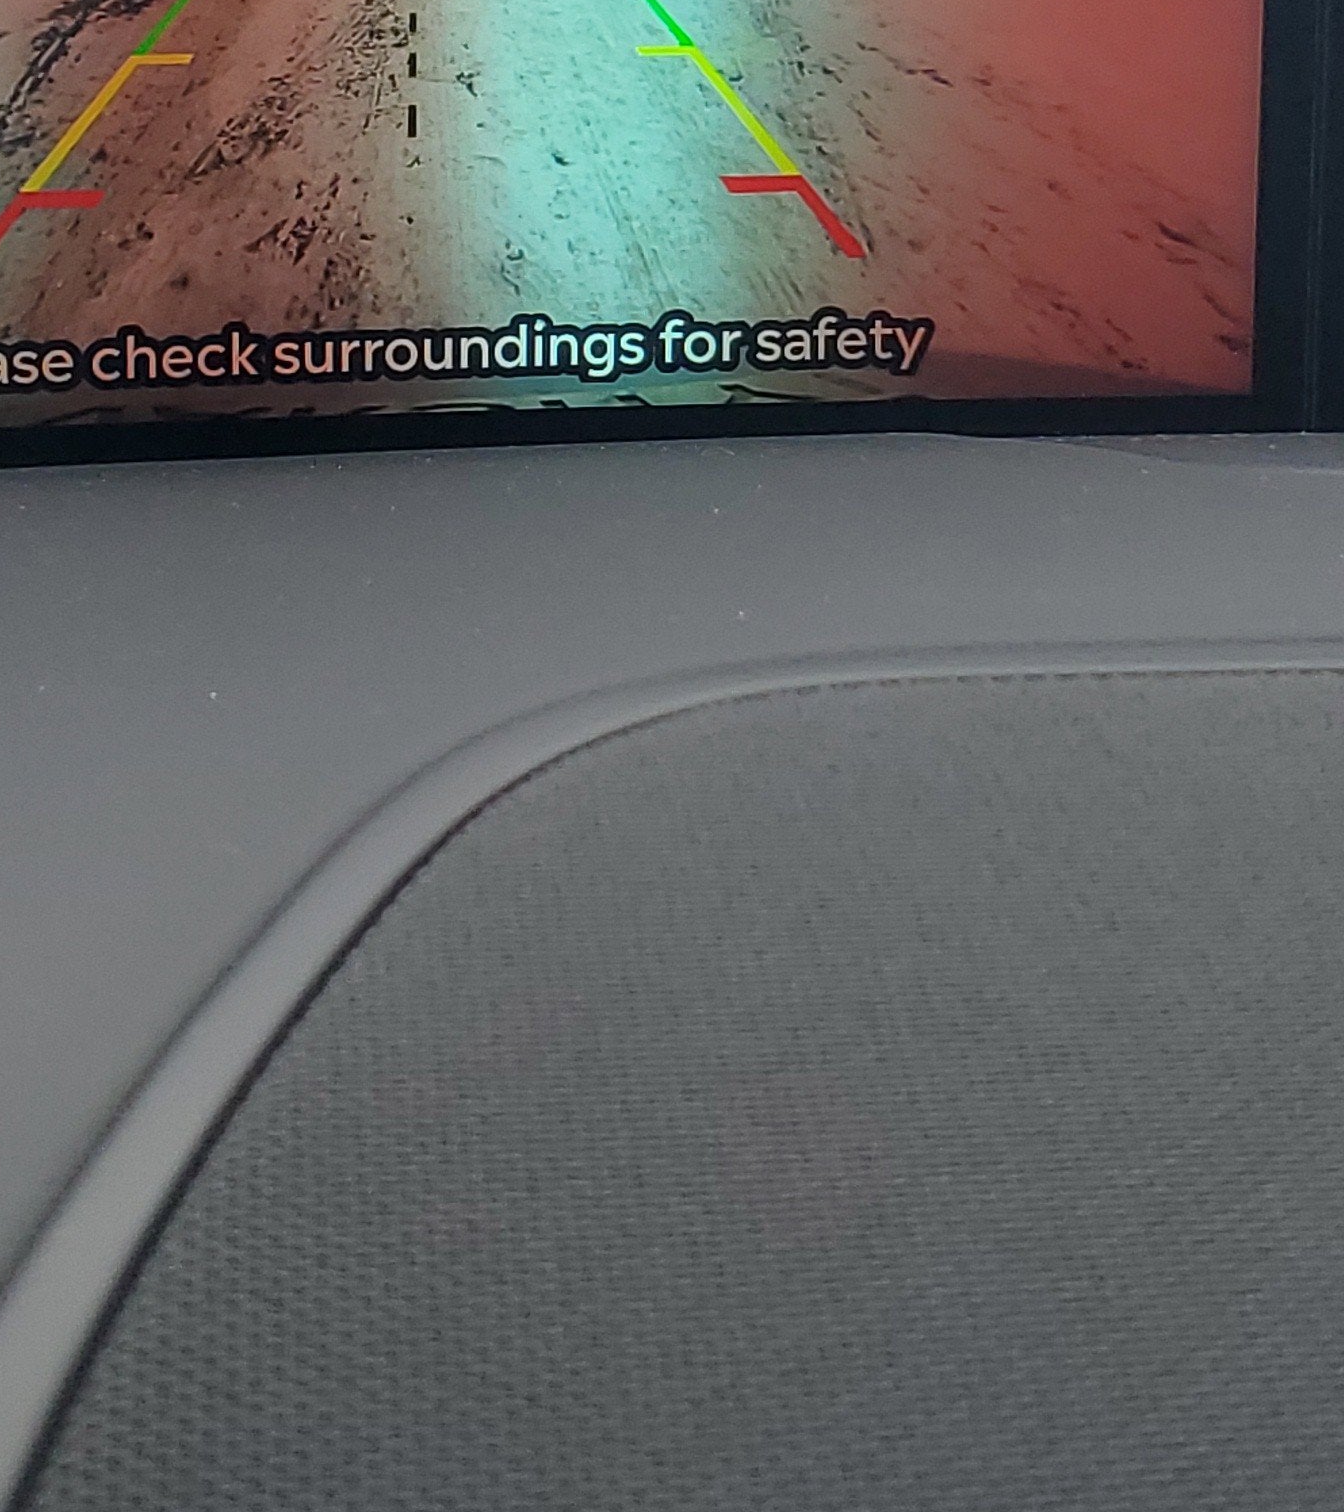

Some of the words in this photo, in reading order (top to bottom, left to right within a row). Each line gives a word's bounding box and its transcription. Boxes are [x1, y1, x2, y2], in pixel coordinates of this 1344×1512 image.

[90, 331, 259, 382] check
[272, 320, 646, 378] surroundings
[658, 318, 742, 364] for
[755, 316, 928, 370] safety
